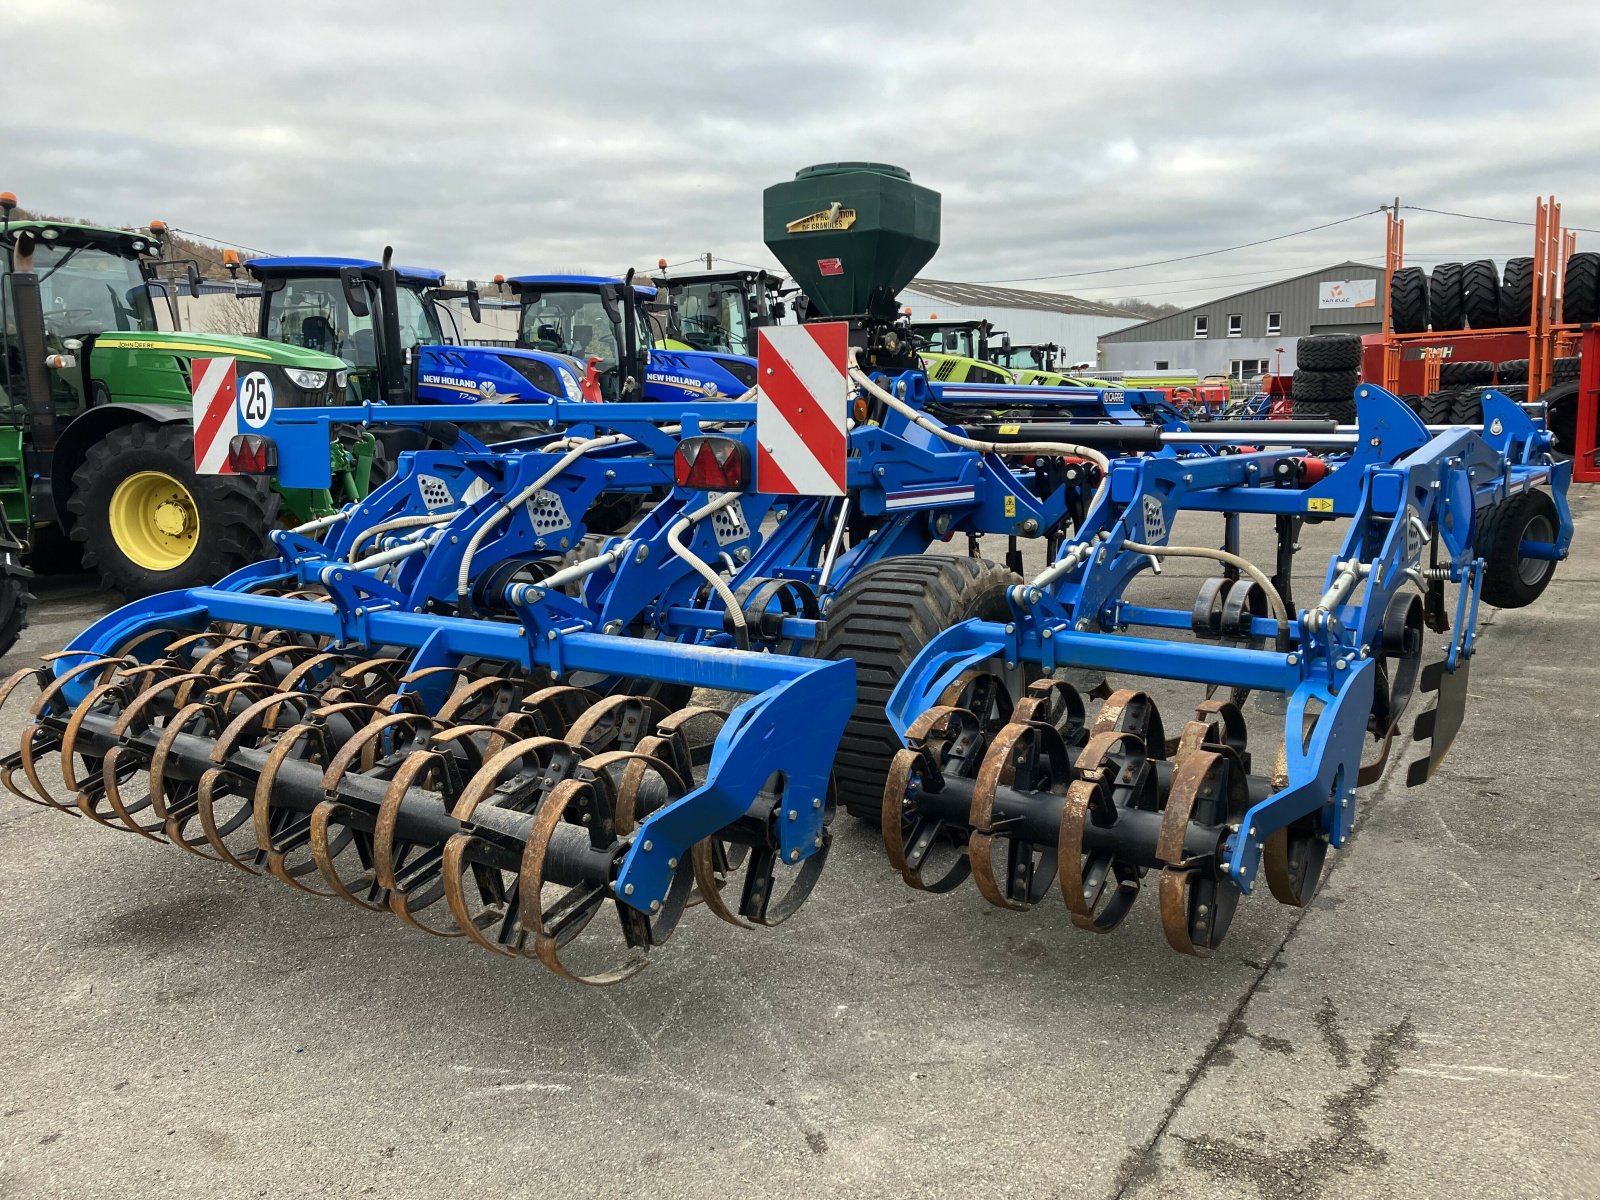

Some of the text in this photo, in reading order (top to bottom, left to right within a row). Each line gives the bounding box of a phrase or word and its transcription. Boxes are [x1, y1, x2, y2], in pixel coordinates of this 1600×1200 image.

[423, 375, 477, 389] NEW HOLLAND
[646, 373, 702, 387] NEW HOLLAND
[245, 378, 266, 420] 25
